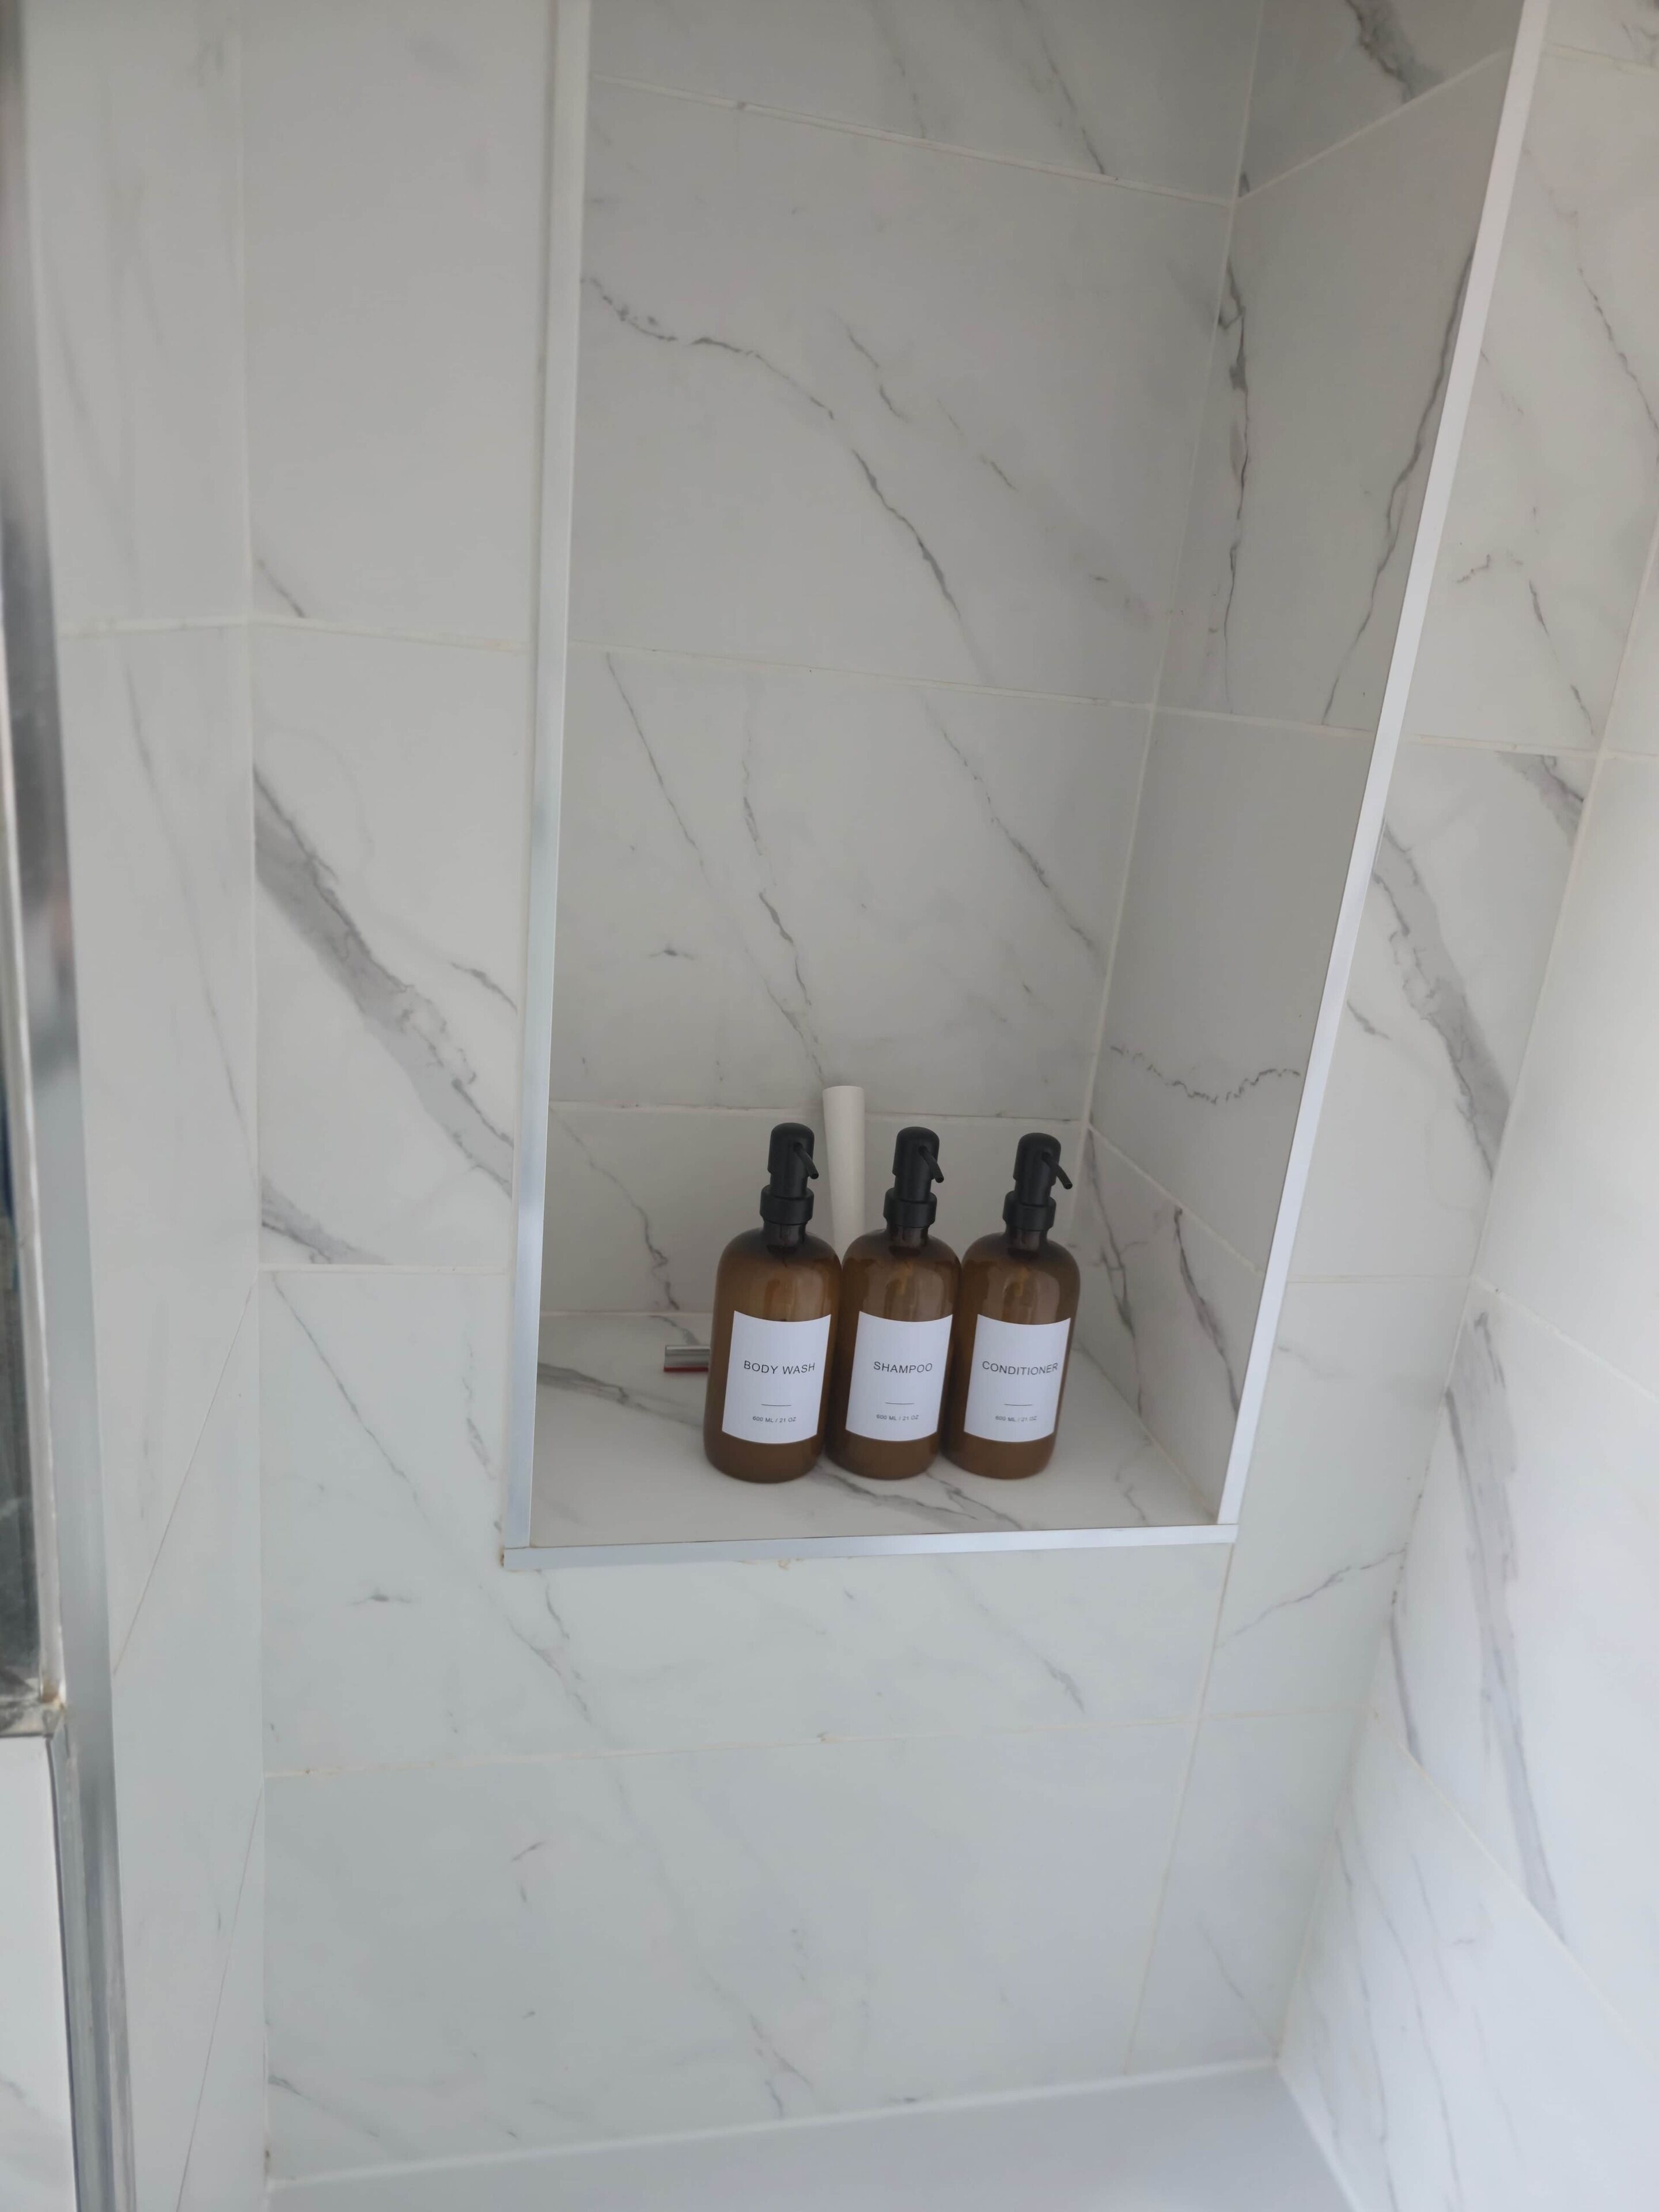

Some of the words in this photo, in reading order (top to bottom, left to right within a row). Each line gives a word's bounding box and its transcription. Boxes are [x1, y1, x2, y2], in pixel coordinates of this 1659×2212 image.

[744, 1360, 778, 1374] BODY
[782, 1362, 816, 1374] WASH
[873, 1361, 933, 1374] SHAMPOO
[982, 1361, 1058, 1376] CONDITIONER
